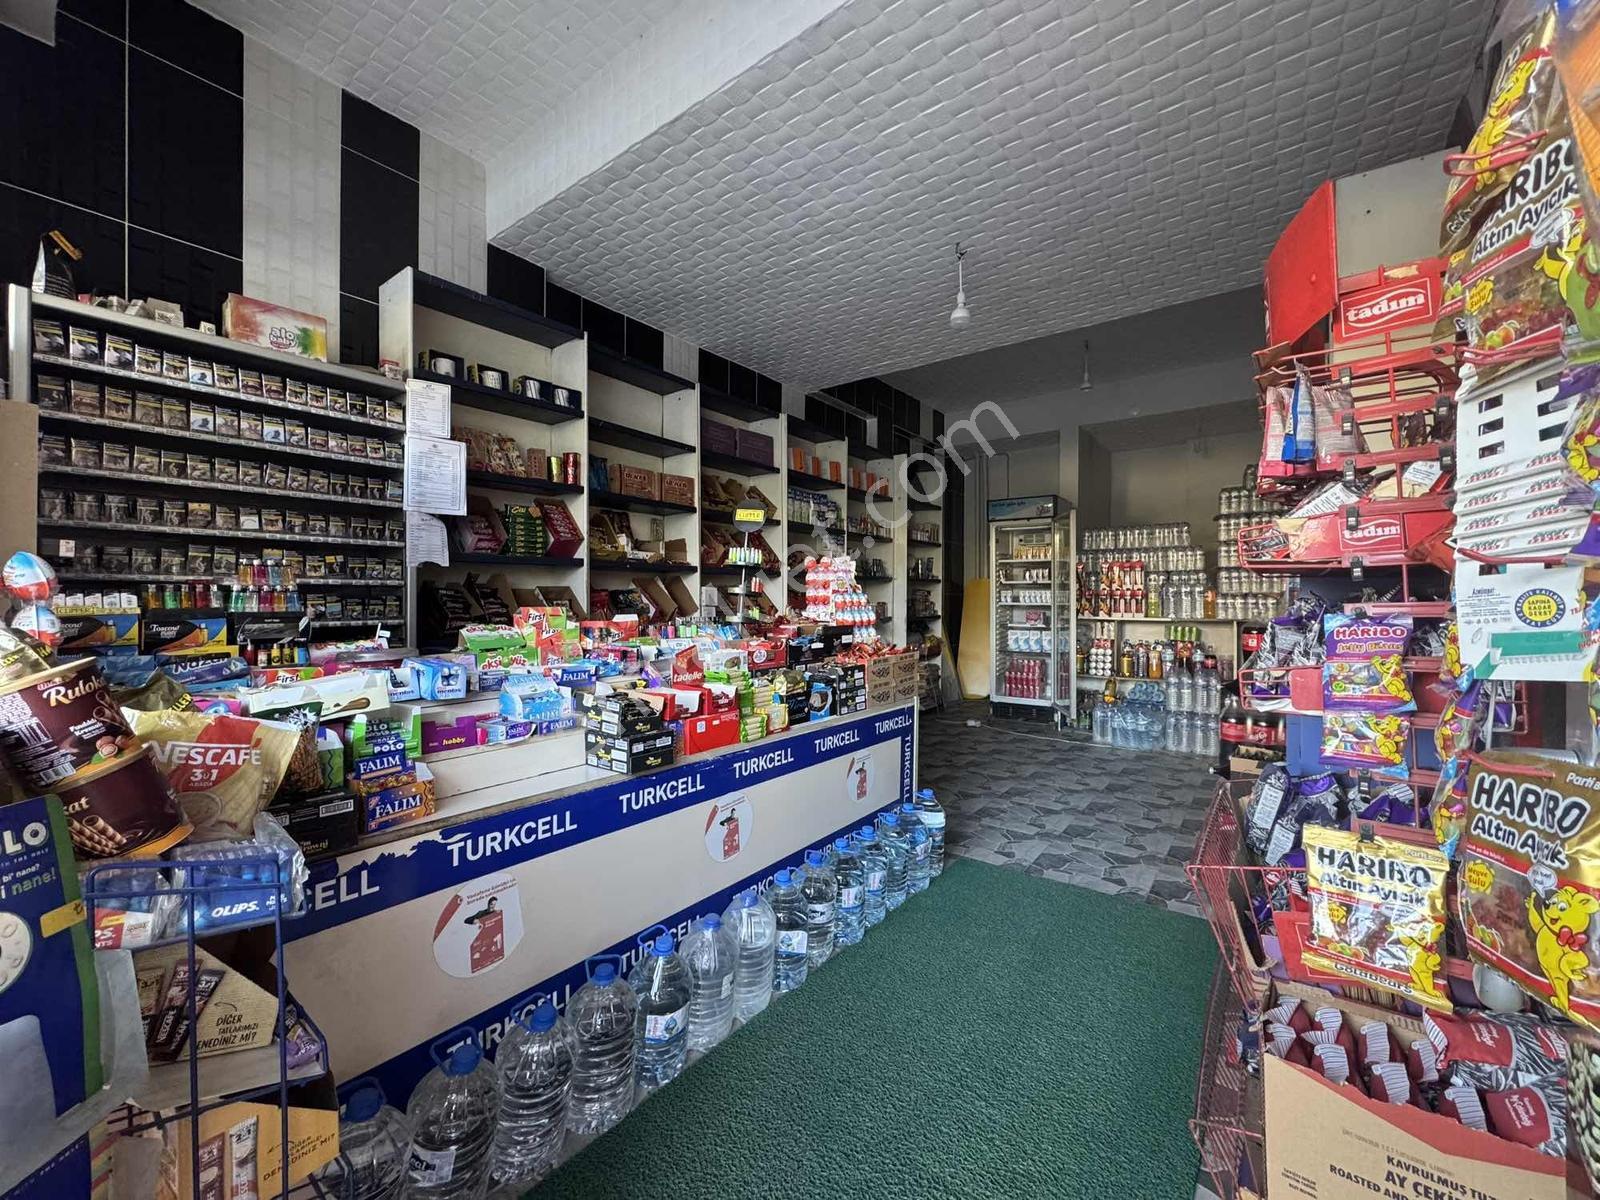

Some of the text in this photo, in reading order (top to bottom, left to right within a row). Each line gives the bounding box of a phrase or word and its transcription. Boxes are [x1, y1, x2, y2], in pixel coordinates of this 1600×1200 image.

[1334, 626, 1407, 640] HARIBO
[562, 670, 590, 681] FALIM
[875, 714, 911, 735] TURKCELL
[373, 742, 405, 754] POLO
[814, 729, 860, 755] TURKCELL
[358, 754, 401, 774] FALIM
[733, 747, 795, 780] TURKCELL
[903, 734, 912, 803] TURKCELL
[374, 794, 421, 819] FALIM
[618, 773, 706, 814] TURKCELL
[0, 822, 48, 855] LO
[445, 810, 578, 868] TURKCELL
[1471, 813, 1519, 849] Altın
[306, 870, 380, 911] ELL
[1329, 1163, 1382, 1194] ROASTED
[1385, 1169, 1408, 1189] AY
[1386, 1154, 1468, 1197] KAVRULMUŞ
